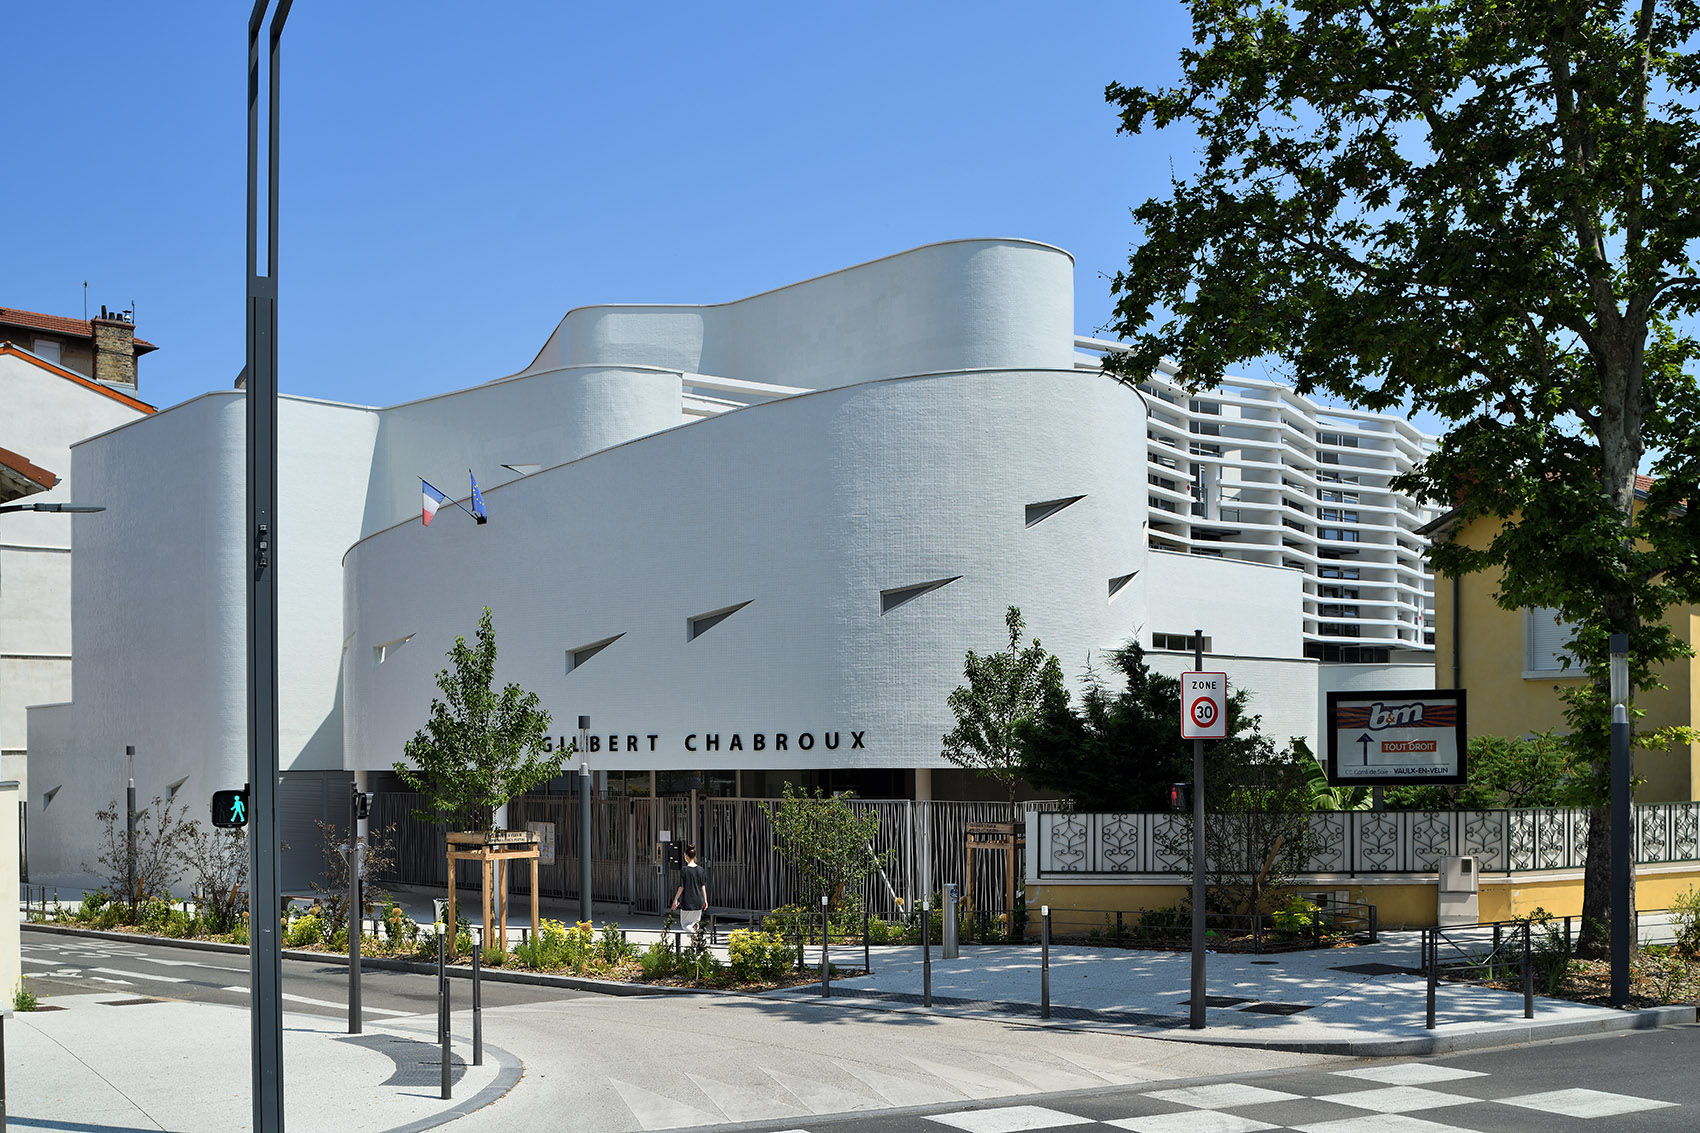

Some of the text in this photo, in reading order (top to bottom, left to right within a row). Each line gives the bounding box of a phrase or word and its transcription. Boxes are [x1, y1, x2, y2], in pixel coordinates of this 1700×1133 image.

[1191, 681, 1217, 690] ZONE
[1196, 705, 1213, 719] 30
[1368, 702, 1425, 730] b&m
[542, 731, 866, 753] GILBERT CHABROUX
[21, 942, 137, 952] ONE
